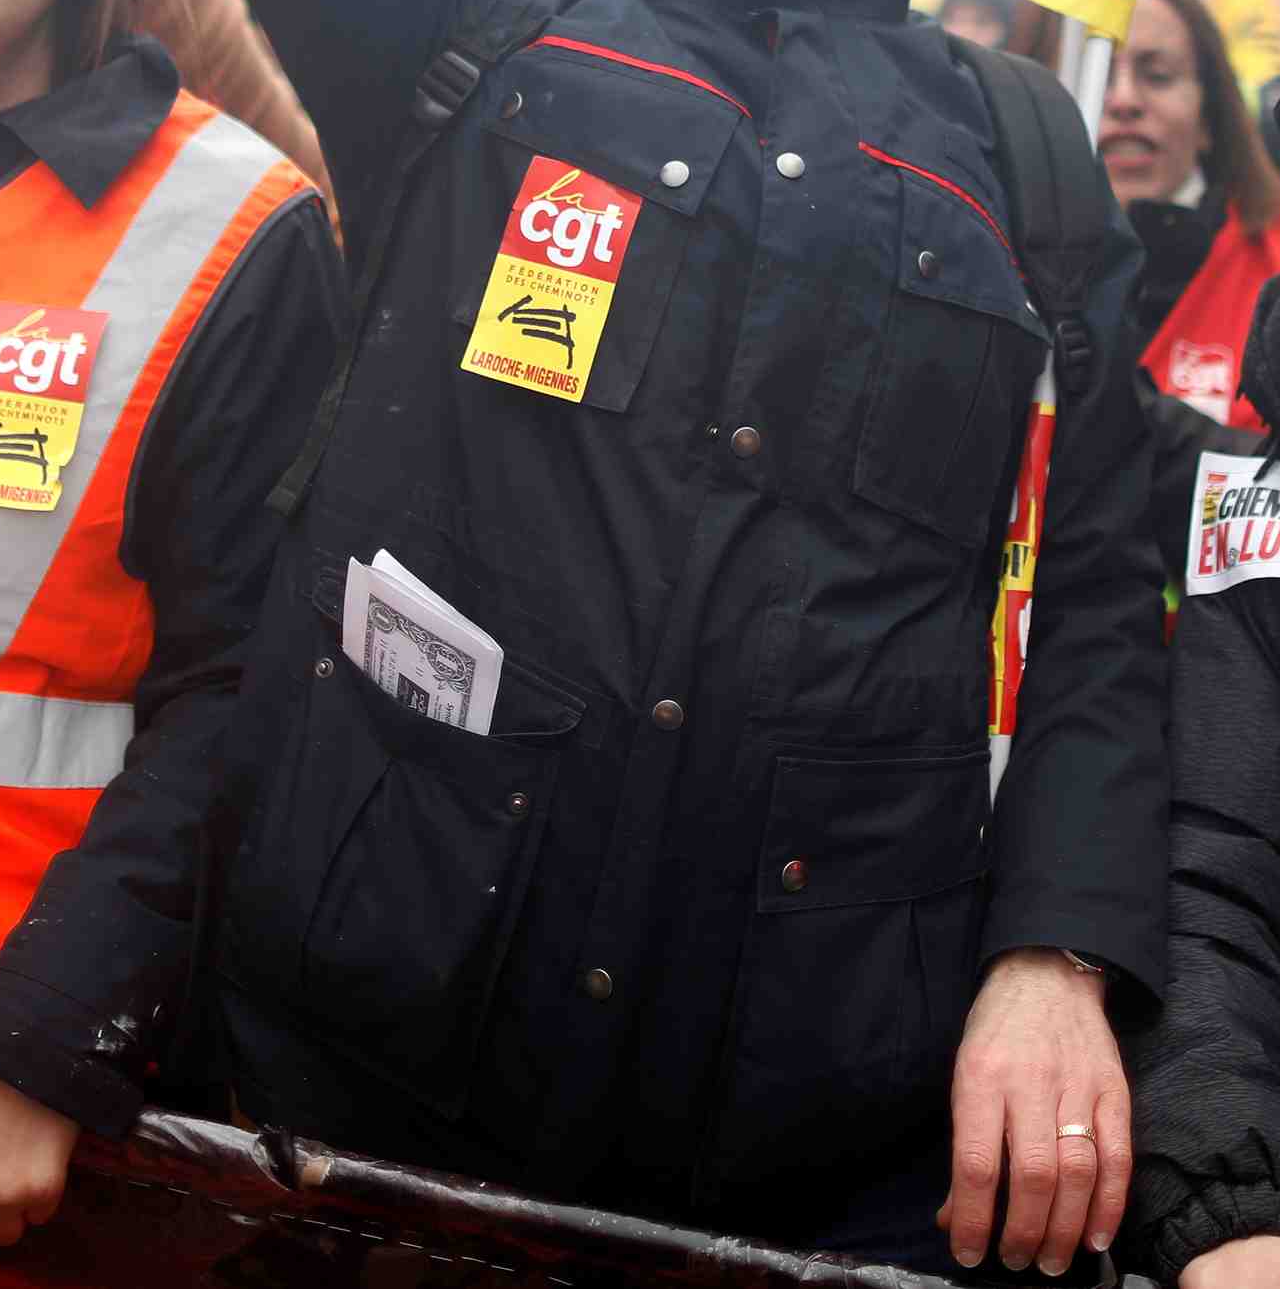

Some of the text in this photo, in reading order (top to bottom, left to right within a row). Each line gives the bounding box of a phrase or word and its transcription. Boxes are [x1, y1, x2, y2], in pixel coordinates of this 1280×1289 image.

[519, 203, 622, 267] cgt
[506, 274, 596, 306] DES CHEMINOTS
[470, 349, 580, 395] LAROCHE-MIGENNES
[0, 408, 66, 426] CHEMINOTS
